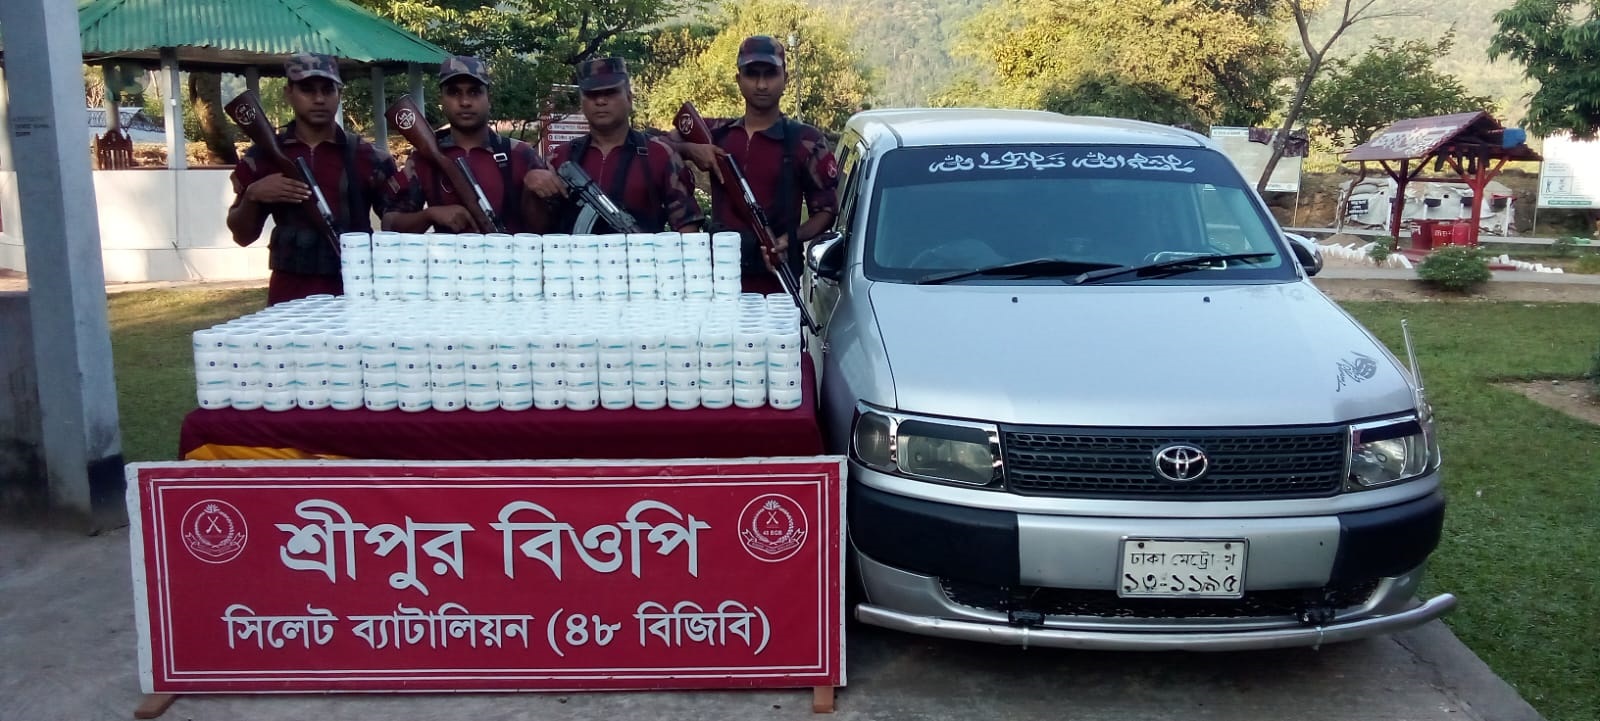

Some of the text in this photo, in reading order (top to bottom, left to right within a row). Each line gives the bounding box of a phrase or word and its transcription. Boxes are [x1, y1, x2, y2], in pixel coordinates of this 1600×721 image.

[273, 499, 712, 596] শ্রীপুর বিওপি
[1131, 552, 1167, 565] ঢাকা
[220, 600, 771, 657] সিলেট ব্যাটালিয়ন (৪৮ বিজিবি)
